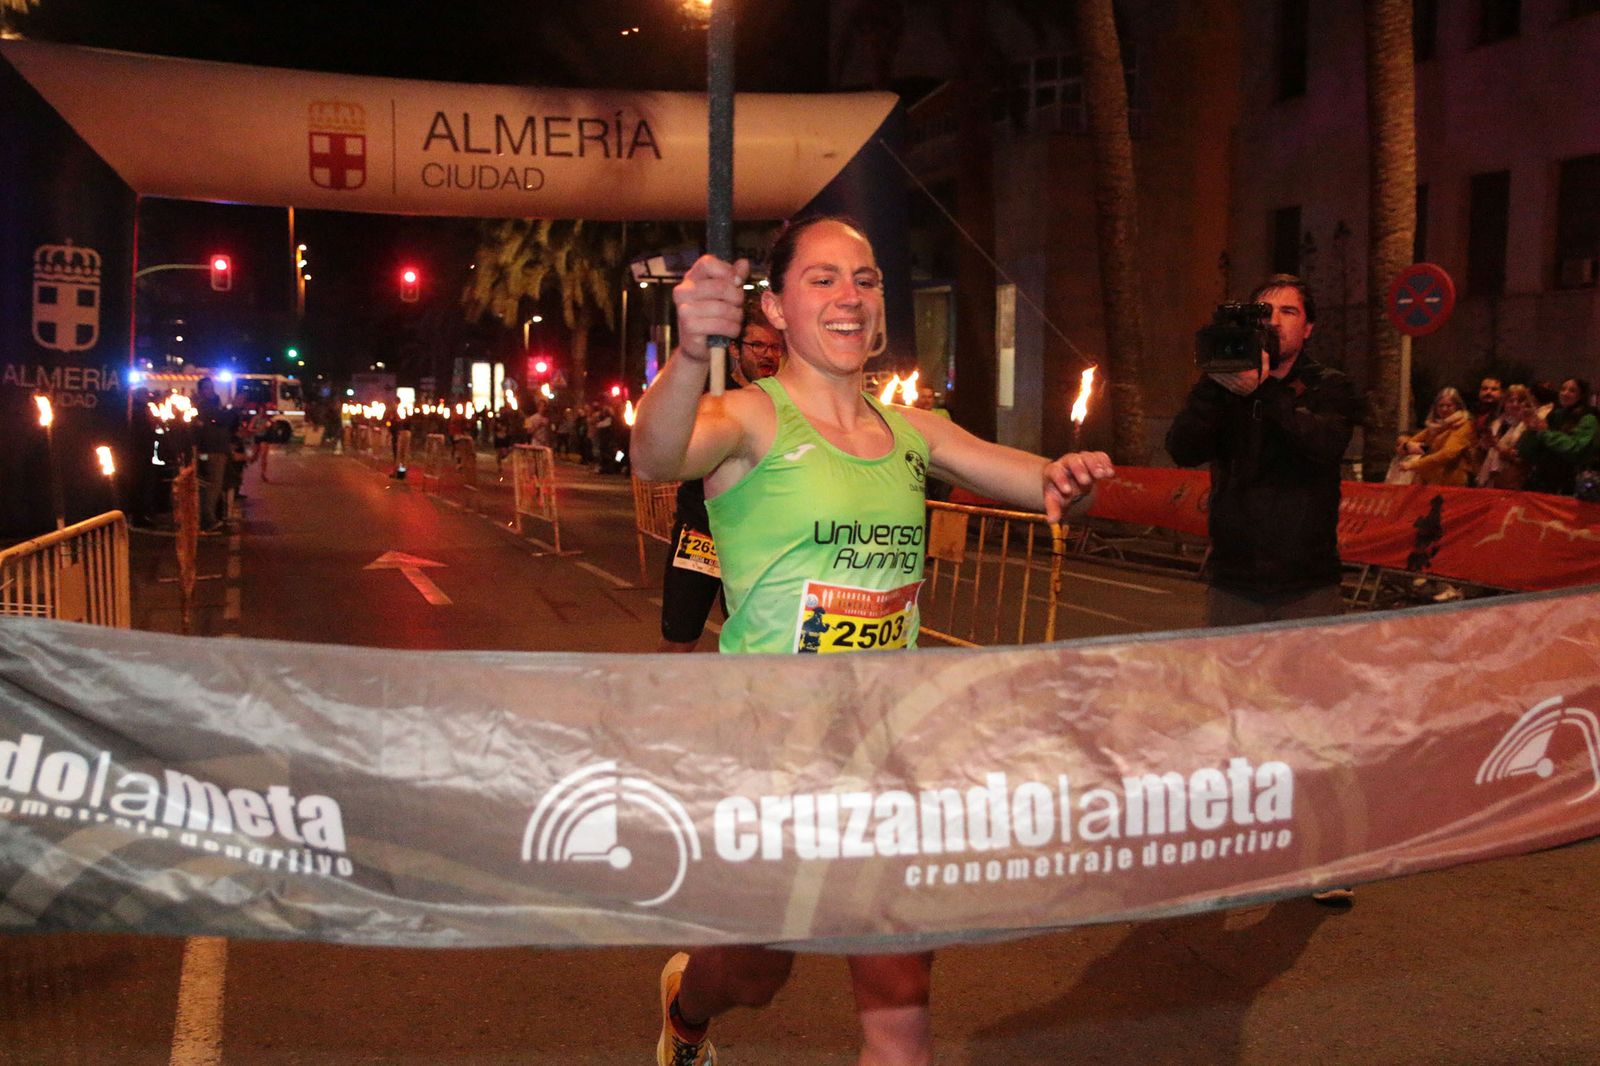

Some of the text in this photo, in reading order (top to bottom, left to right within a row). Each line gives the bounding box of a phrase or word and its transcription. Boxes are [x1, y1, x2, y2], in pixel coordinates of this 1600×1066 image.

[423, 110, 662, 160] ALMERÍA
[421, 161, 545, 192] CIUDAD
[2, 363, 121, 391] ALMERÍA
[814, 520, 922, 545] Universo
[833, 548, 917, 574] Running
[832, 615, 905, 649] 2503
[713, 757, 1293, 863] cruzandolameta
[905, 828, 1292, 888] cronometraje deportivo
